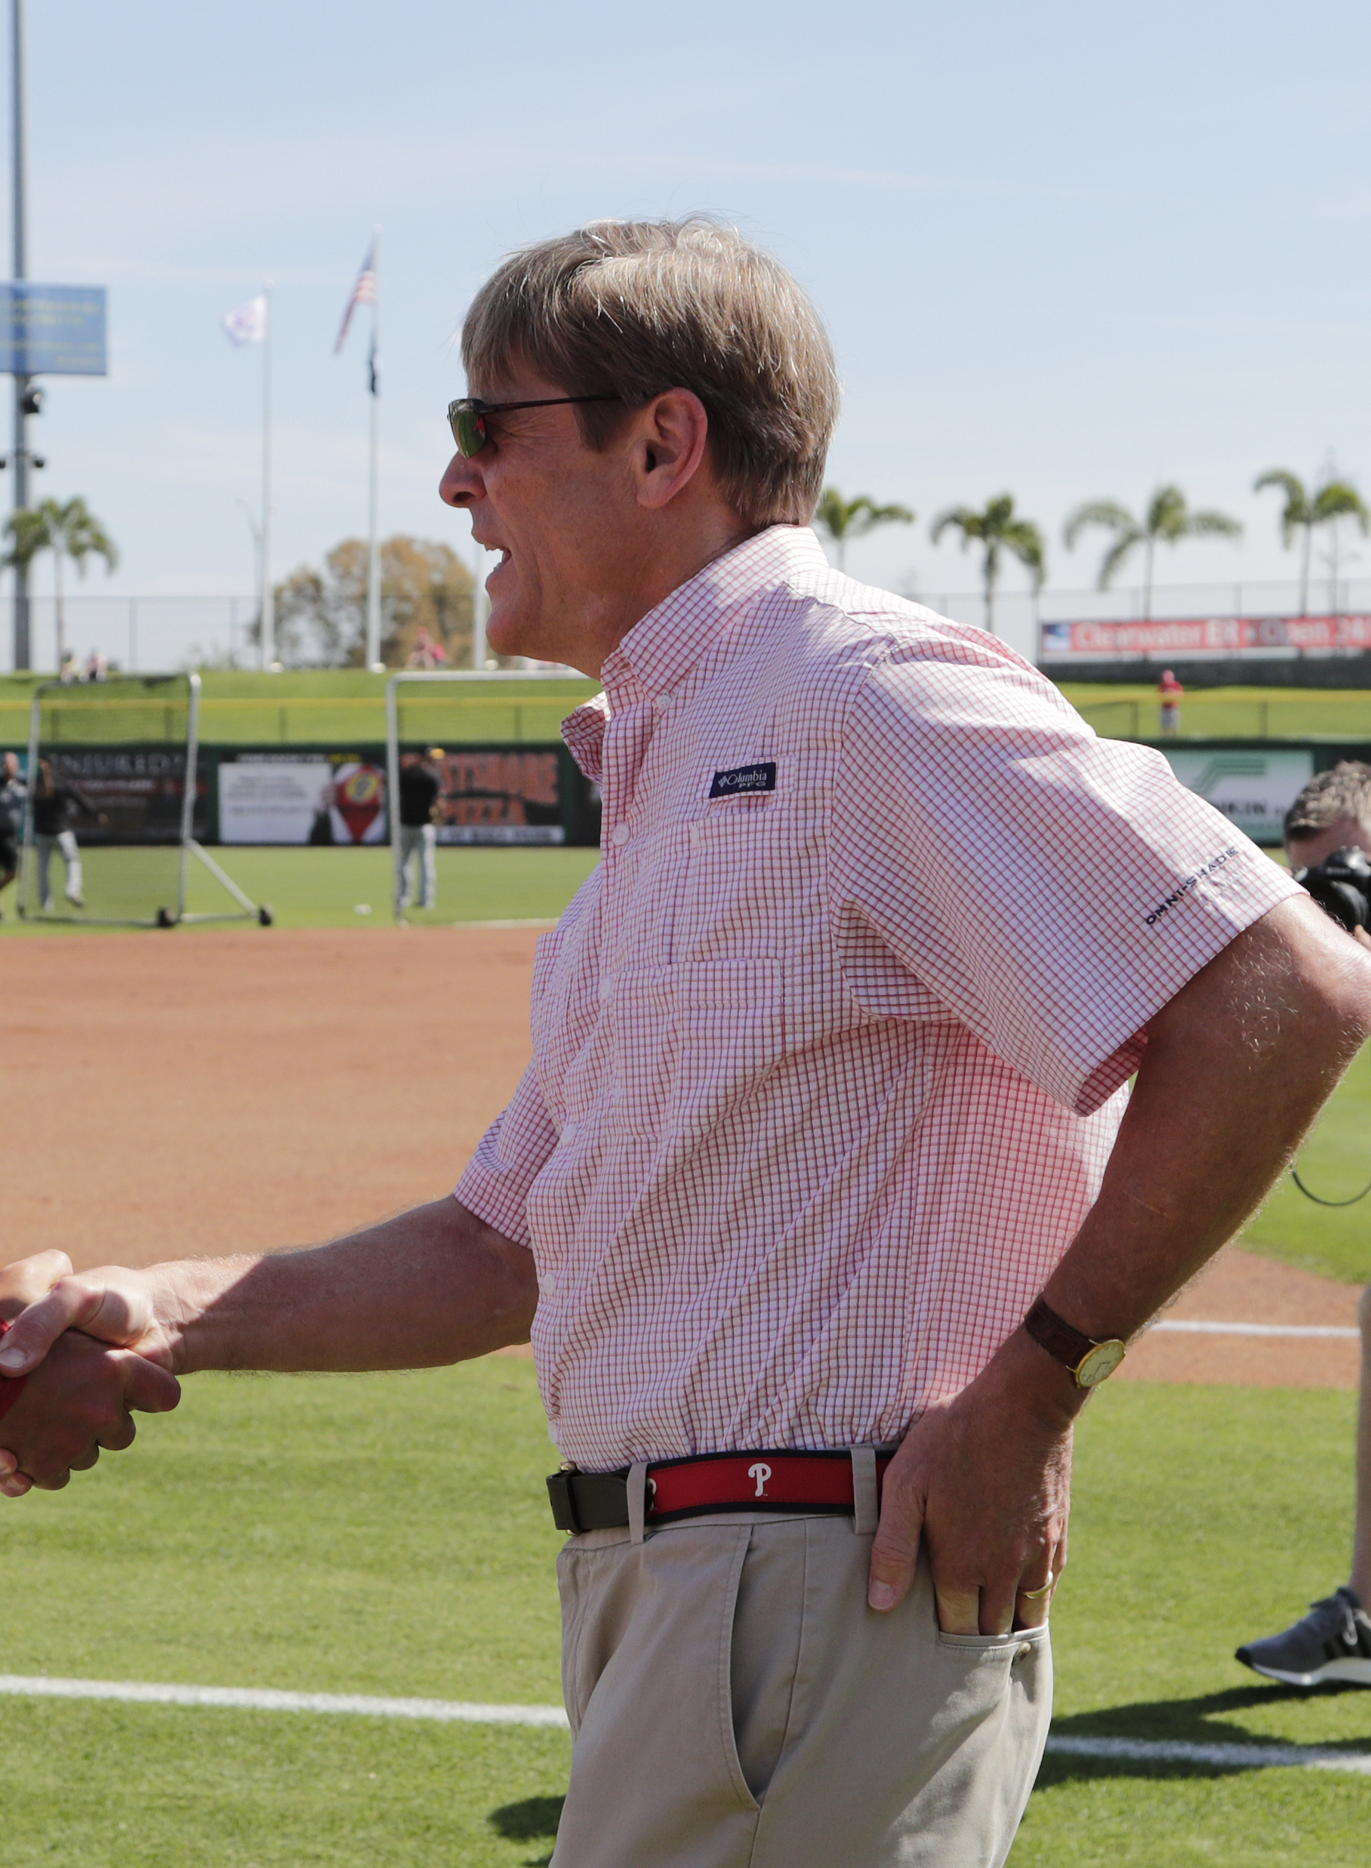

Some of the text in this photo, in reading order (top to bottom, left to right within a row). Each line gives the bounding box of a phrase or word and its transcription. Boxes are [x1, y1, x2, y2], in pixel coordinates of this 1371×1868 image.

[1073, 622, 1201, 649] Clearwater
[1205, 619, 1239, 647] ER
[727, 770, 767, 786] Columbia
[1145, 846, 1239, 925] OMNI-SHADE
[747, 1462, 772, 1497] P
